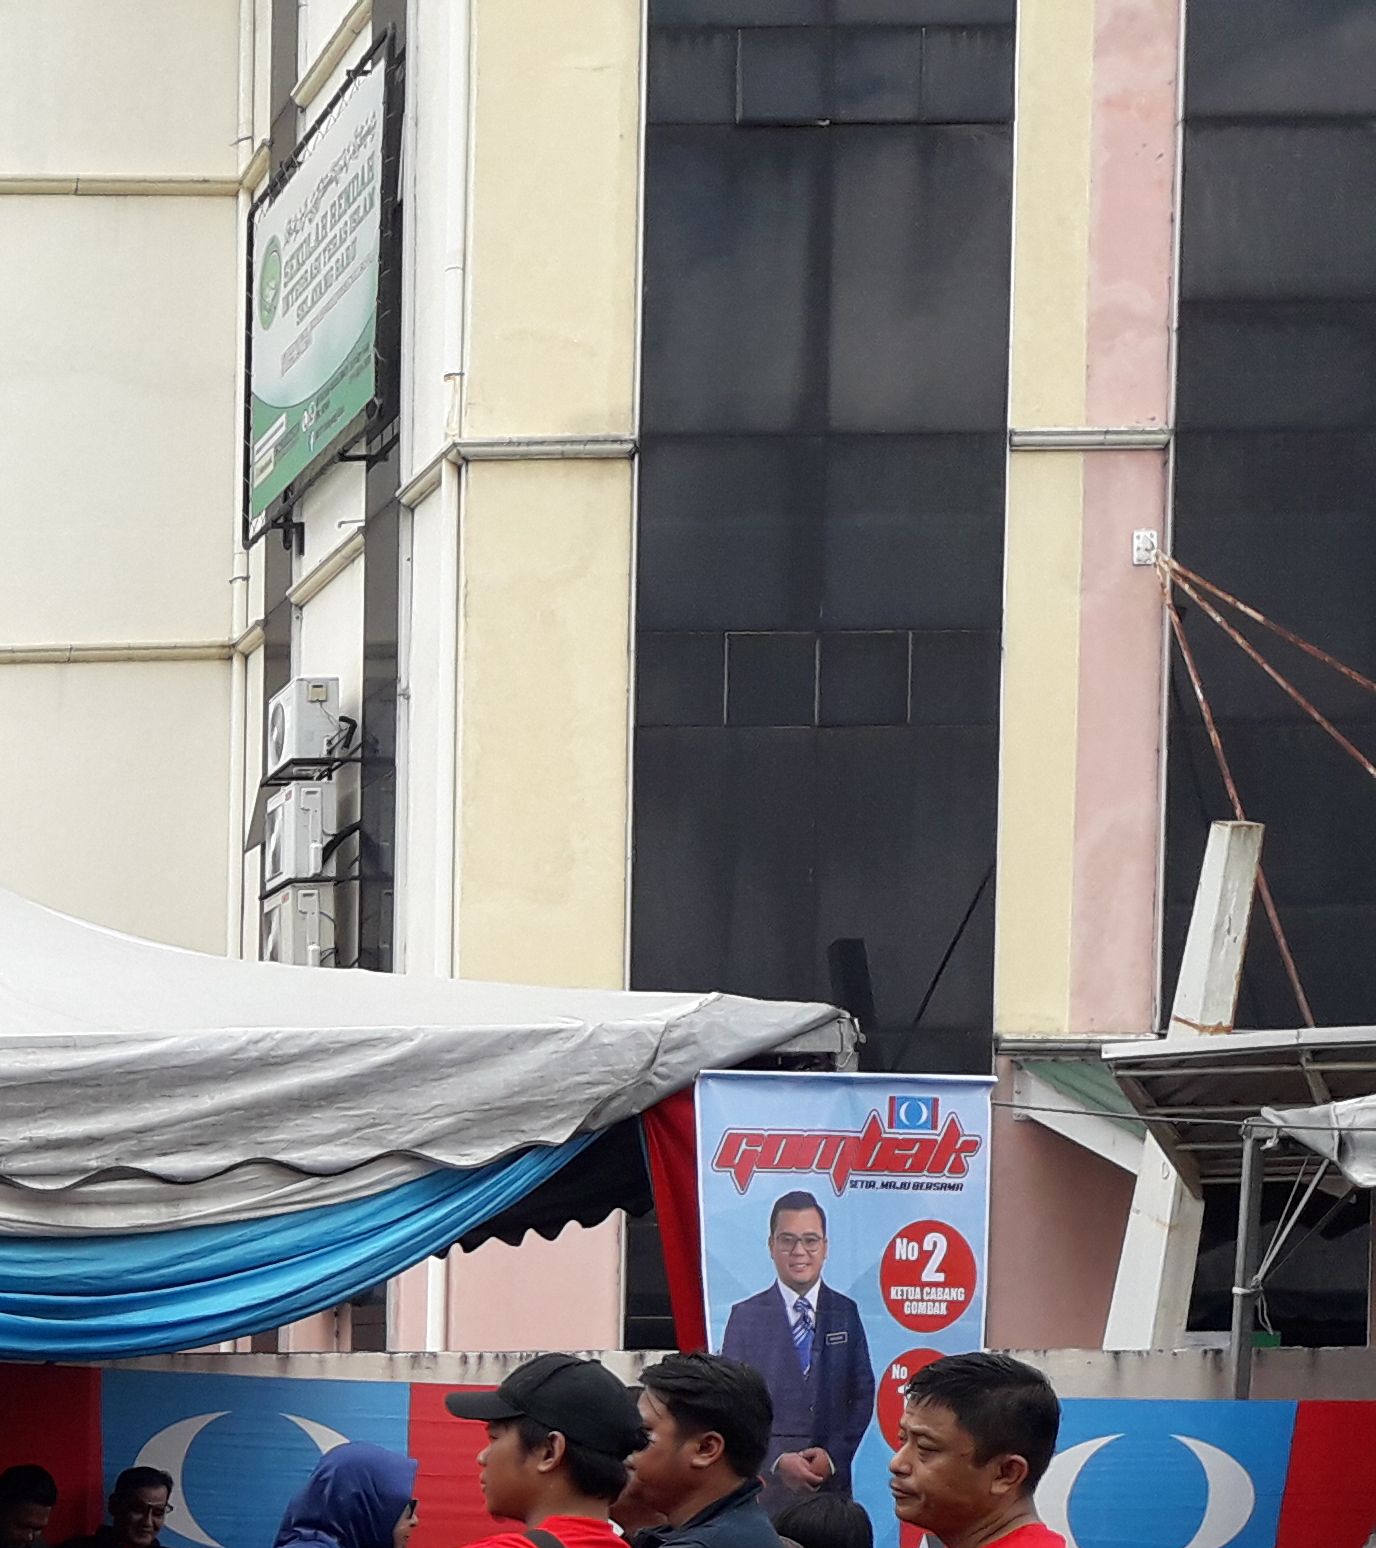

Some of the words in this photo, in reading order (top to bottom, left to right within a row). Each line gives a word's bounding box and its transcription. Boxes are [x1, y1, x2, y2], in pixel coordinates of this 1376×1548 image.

[880, 1181, 910, 1190] MAJU
[912, 1182, 963, 1192] BERSAMA
[921, 1232, 948, 1282] 2
[890, 1286, 922, 1300] KETUA
[923, 1287, 965, 1301] CABANG
[904, 1301, 947, 1315] GOMBAK
